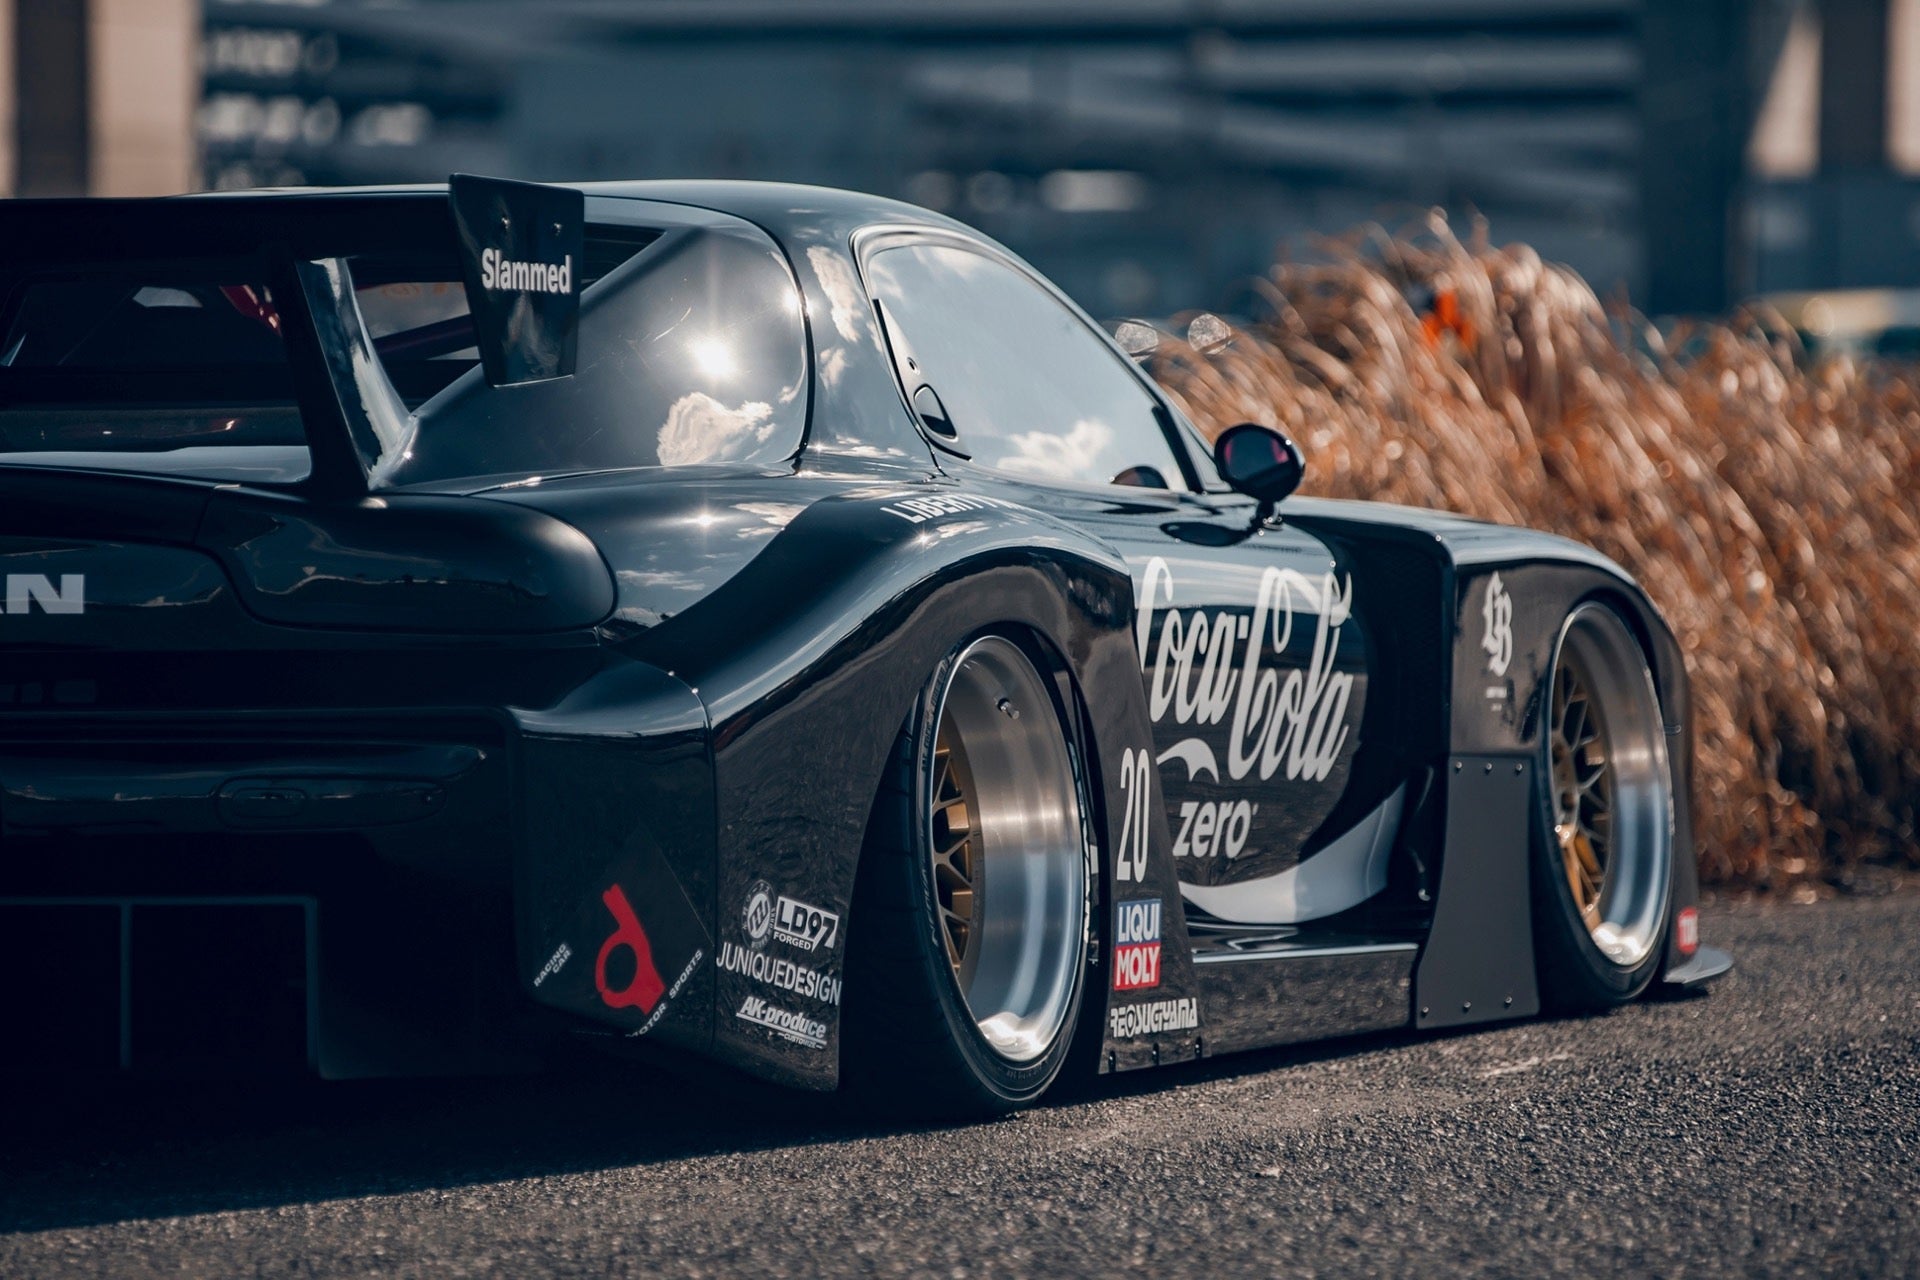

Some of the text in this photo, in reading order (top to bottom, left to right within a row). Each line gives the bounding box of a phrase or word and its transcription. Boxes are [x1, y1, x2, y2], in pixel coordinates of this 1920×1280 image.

[481, 247, 572, 294] Slammed
[0, 574, 84, 614] N
[1116, 747, 1150, 883] 20
[1172, 799, 1251, 858] zero
[773, 931, 812, 951] FORGED
[775, 899, 838, 950] LD97
[1118, 902, 1160, 944] LIQUI
[533, 943, 567, 987] RACING
[552, 949, 571, 973] CAR
[668, 949, 703, 999] SPORTS
[716, 941, 842, 1006] JUNIQUEDESIGN
[1115, 946, 1160, 987] MOLY
[740, 995, 827, 1039] AK-produce
